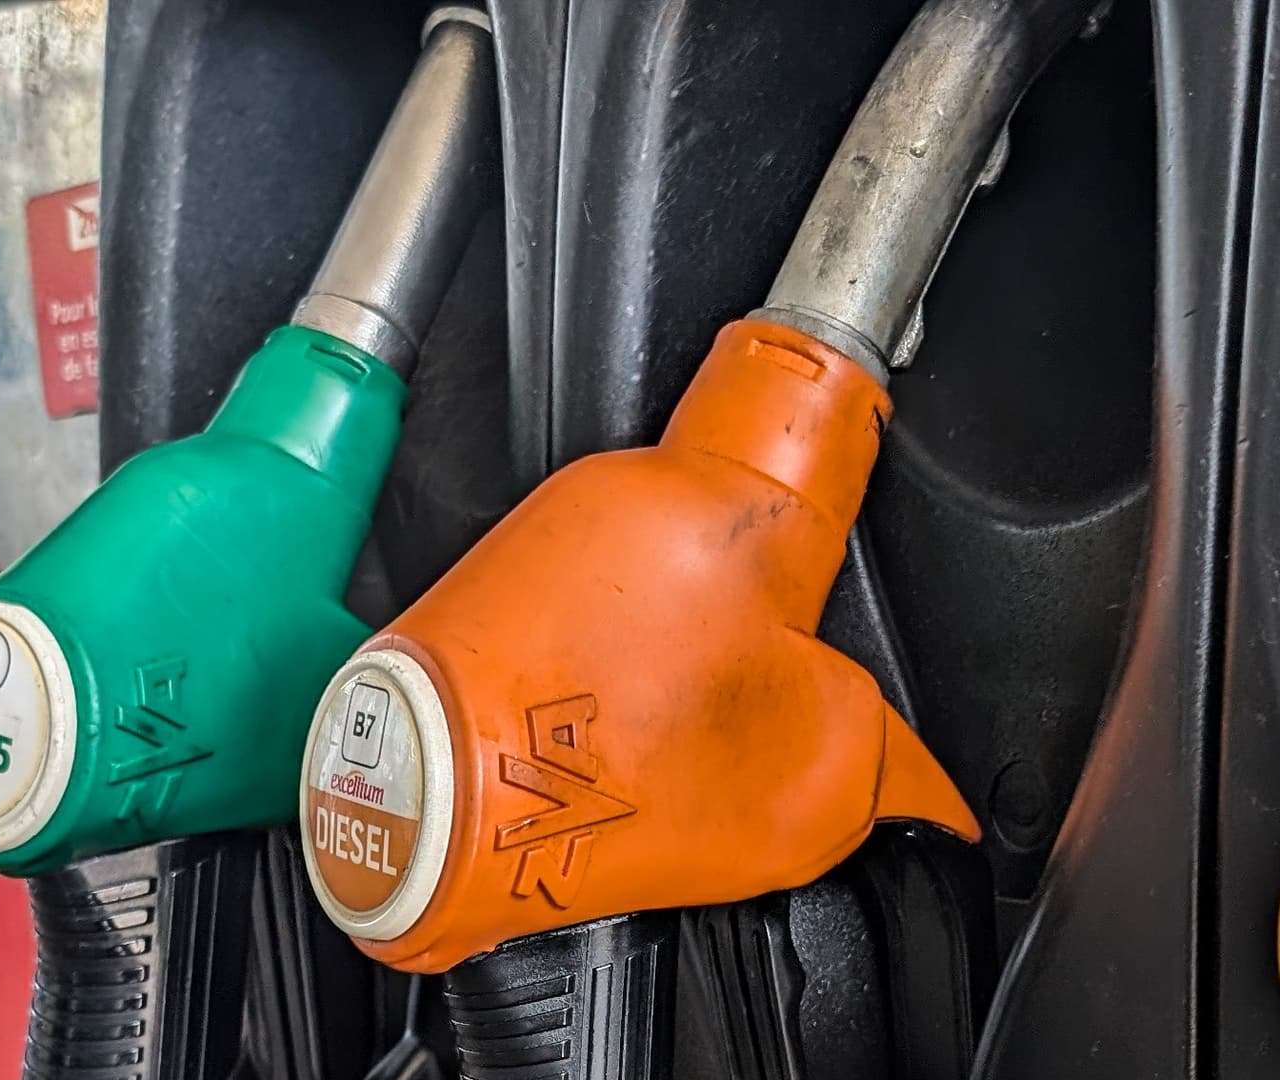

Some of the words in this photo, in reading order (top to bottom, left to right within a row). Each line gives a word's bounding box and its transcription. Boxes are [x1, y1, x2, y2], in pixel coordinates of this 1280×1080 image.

[352, 710, 377, 740] B7
[330, 770, 385, 806] excellium
[493, 692, 638, 911] ZVA
[315, 805, 398, 877] DIESEL
